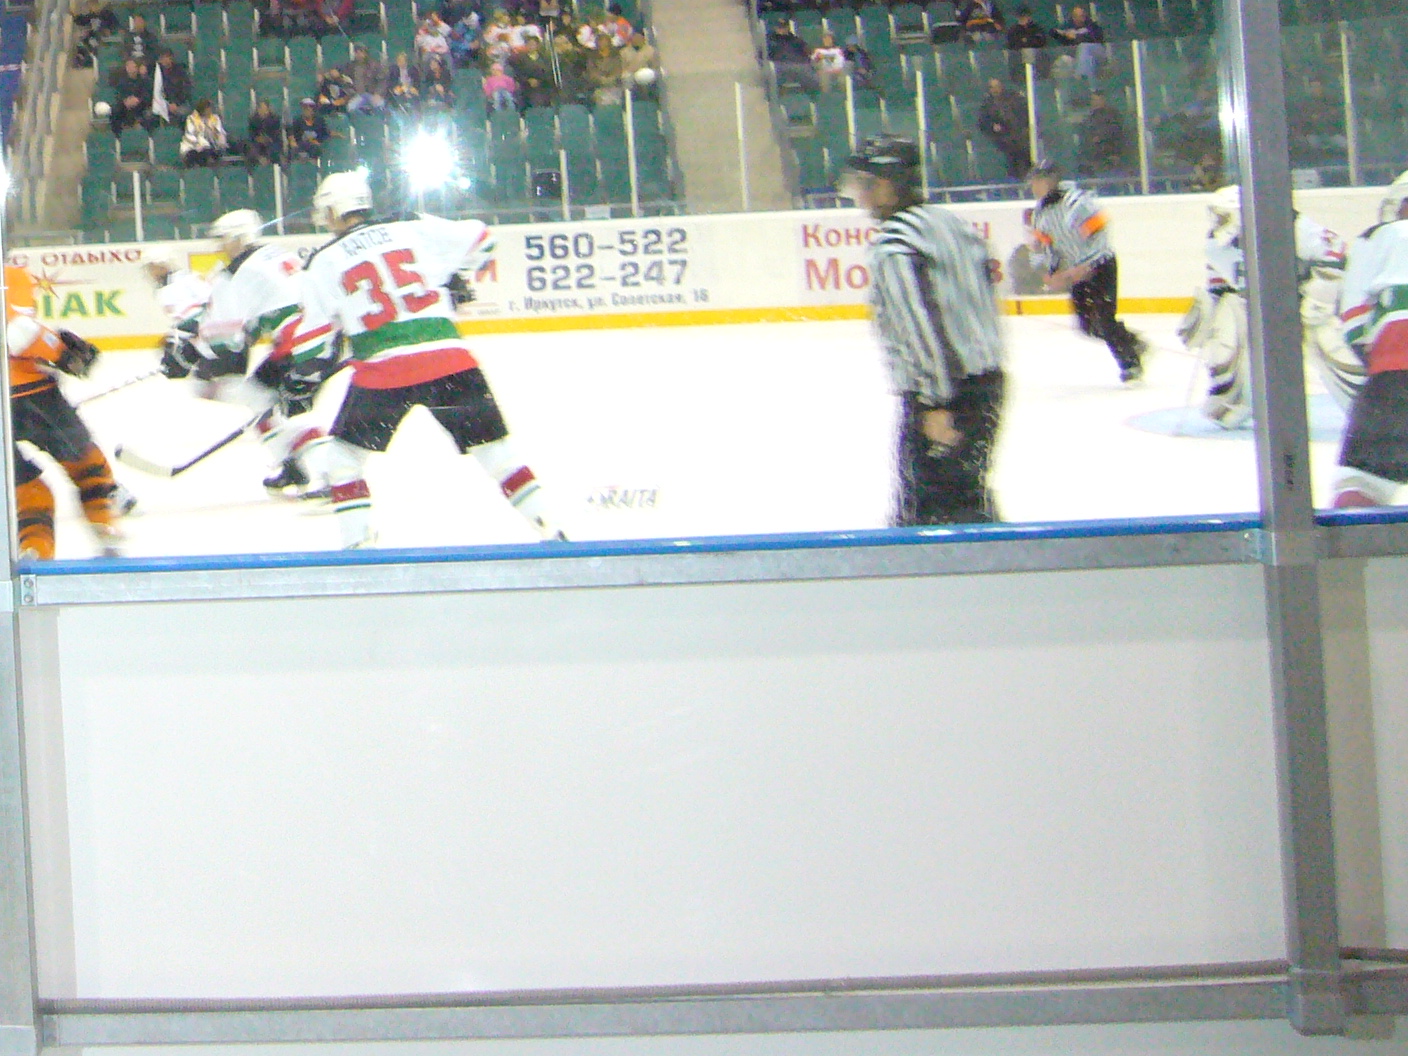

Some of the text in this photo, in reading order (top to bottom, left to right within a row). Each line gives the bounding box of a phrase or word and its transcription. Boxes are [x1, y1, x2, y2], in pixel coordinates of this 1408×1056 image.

[524, 228, 689, 261] 560-522
[342, 248, 441, 331] 35
[526, 258, 688, 291] 622-247
